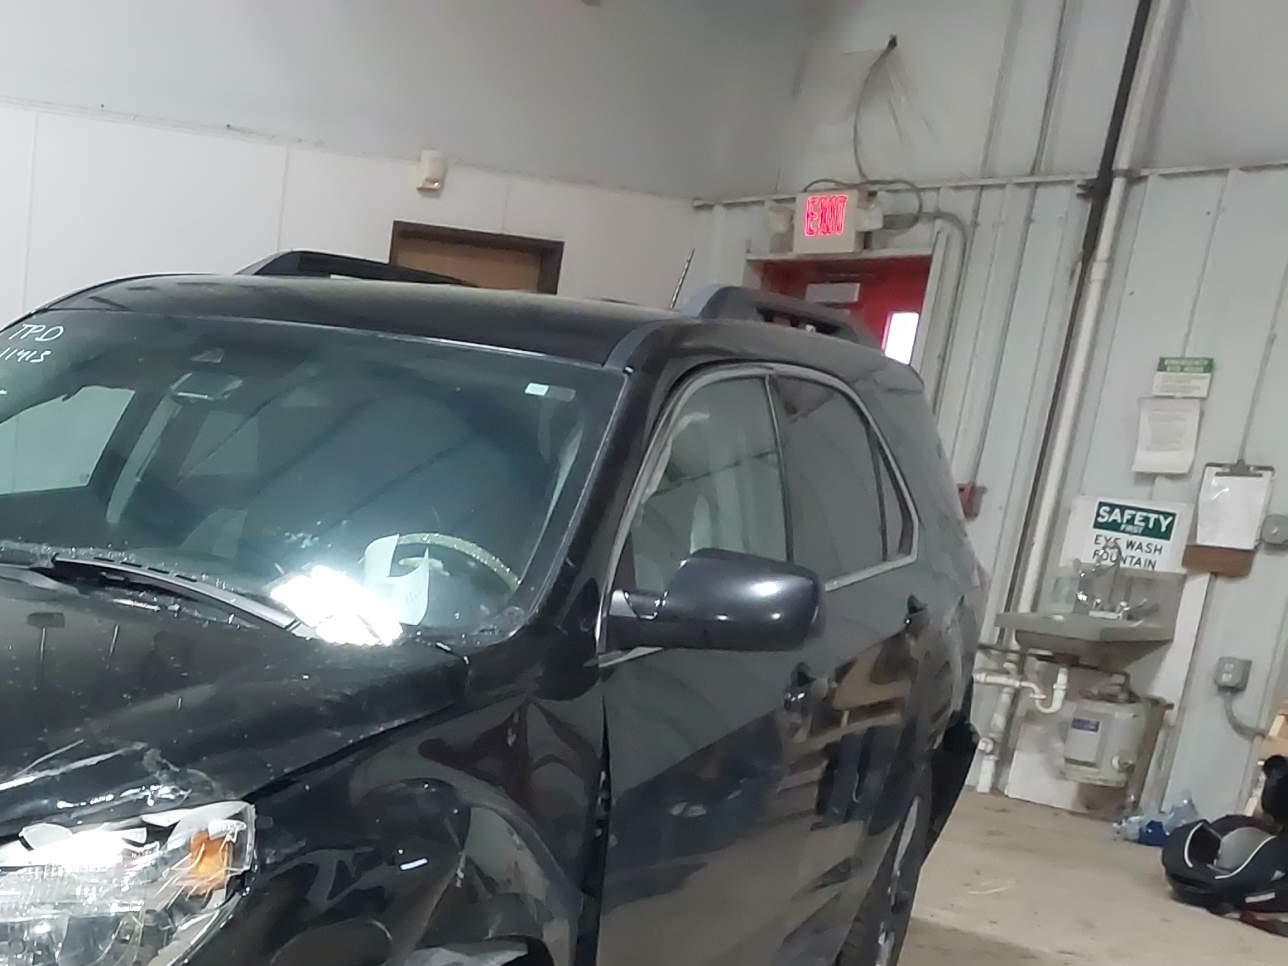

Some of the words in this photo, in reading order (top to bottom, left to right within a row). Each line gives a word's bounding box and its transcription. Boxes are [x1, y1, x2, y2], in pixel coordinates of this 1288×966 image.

[804, 194, 848, 236] EXIT
[8, 323, 64, 342] TPD
[1096, 505, 1173, 533] SAFETY
[1119, 523, 1145, 534] FIRST
[1125, 538, 1164, 556] WASH
